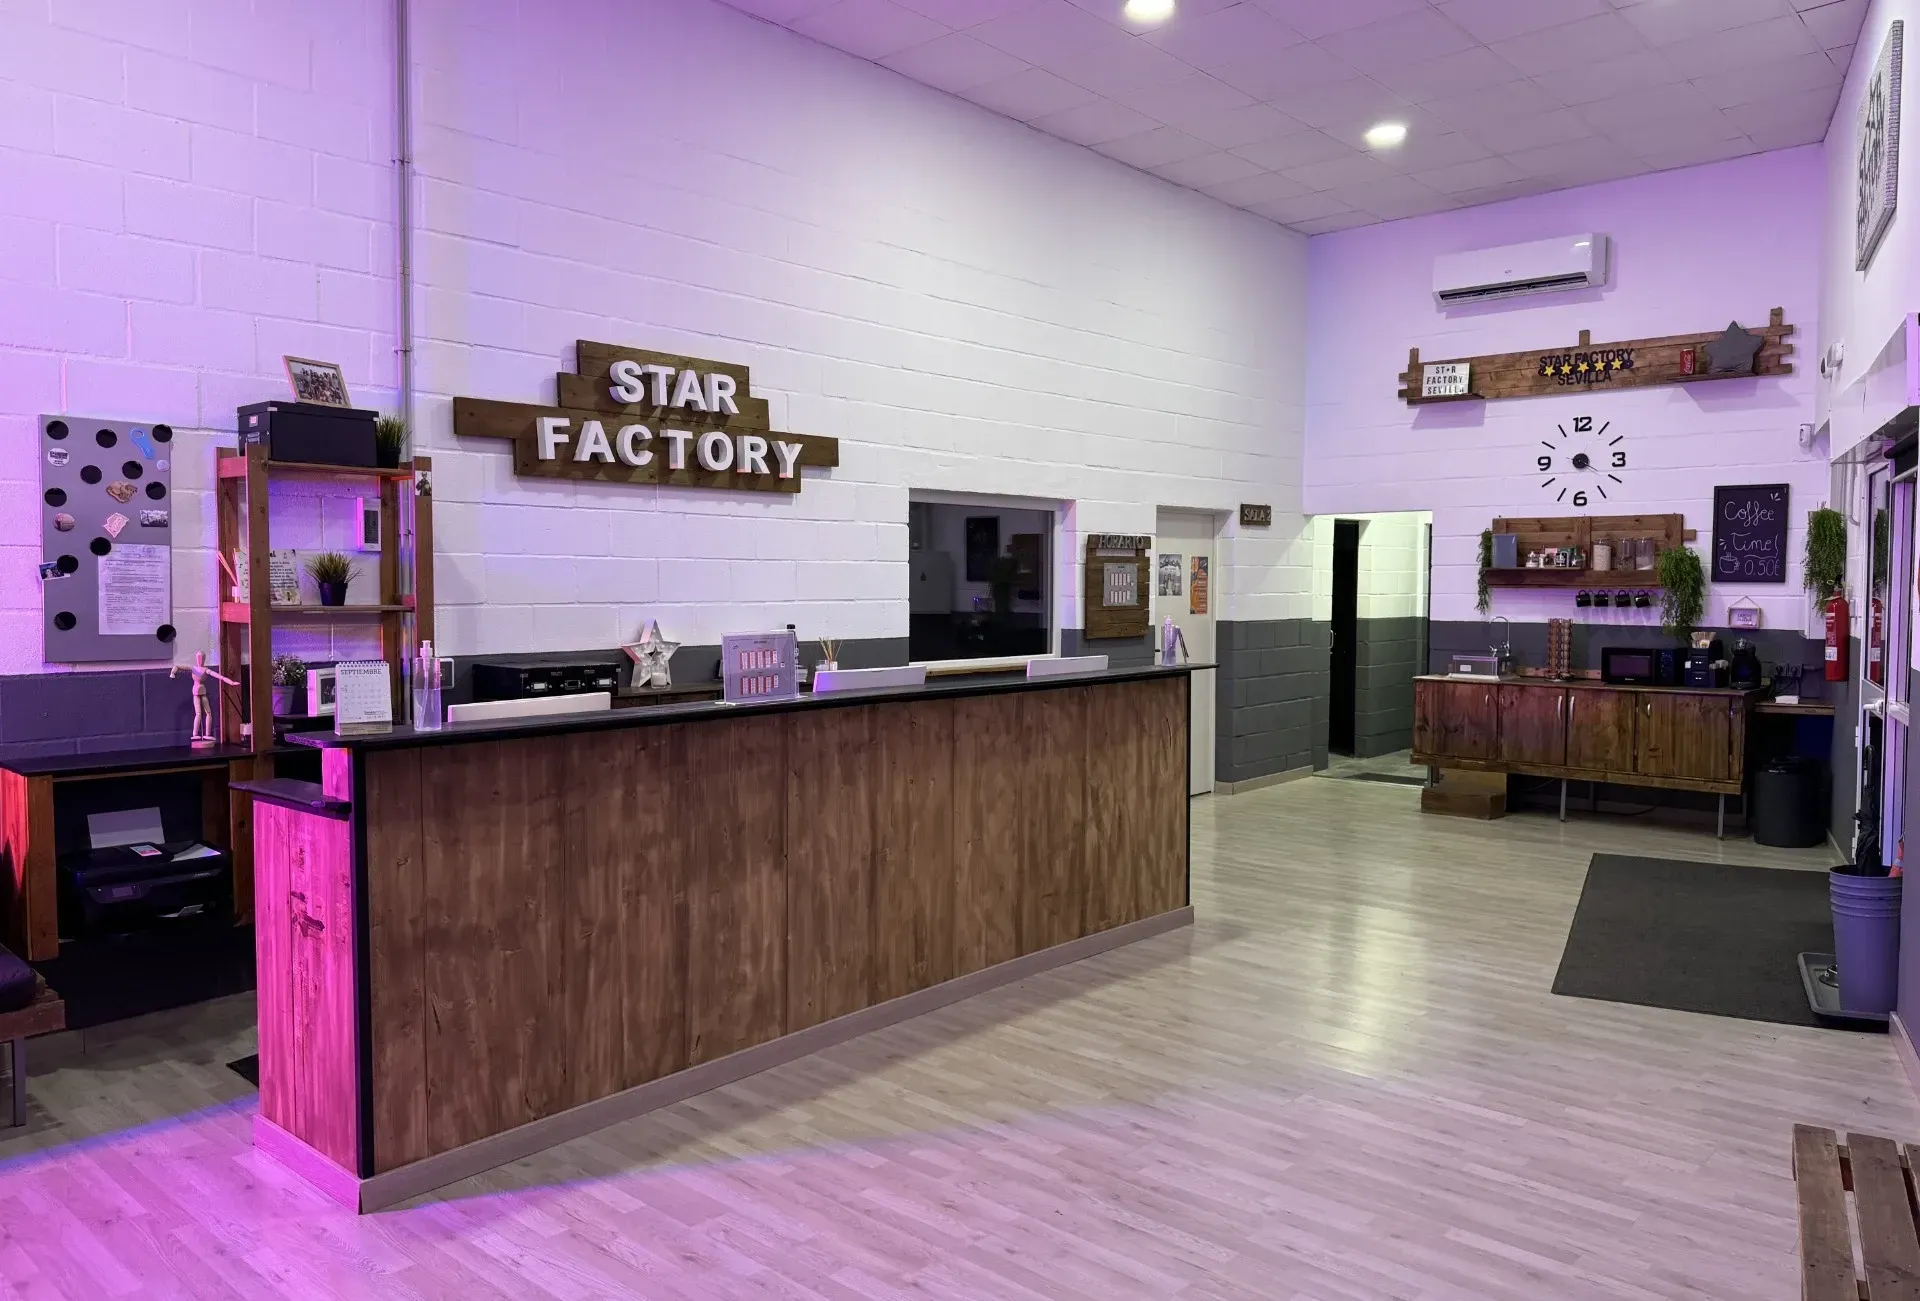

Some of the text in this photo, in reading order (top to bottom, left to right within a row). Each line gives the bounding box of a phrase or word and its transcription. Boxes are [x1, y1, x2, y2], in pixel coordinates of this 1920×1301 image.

[1539, 348, 1634, 367] STAR FACTORY
[1426, 376, 1463, 384] FACTORY
[1557, 370, 1612, 386] SEVILLA
[608, 360, 740, 414] STAR
[1572, 416, 1592, 432] 12
[536, 416, 803, 479] FACTORY
[1537, 456, 1551, 471] 9
[1611, 451, 1626, 467] 3
[1573, 491, 1587, 506] 6
[1244, 509, 1265, 521] SALA
[1724, 500, 1775, 527] Coffee
[1098, 535, 1144, 549] HORARIO
